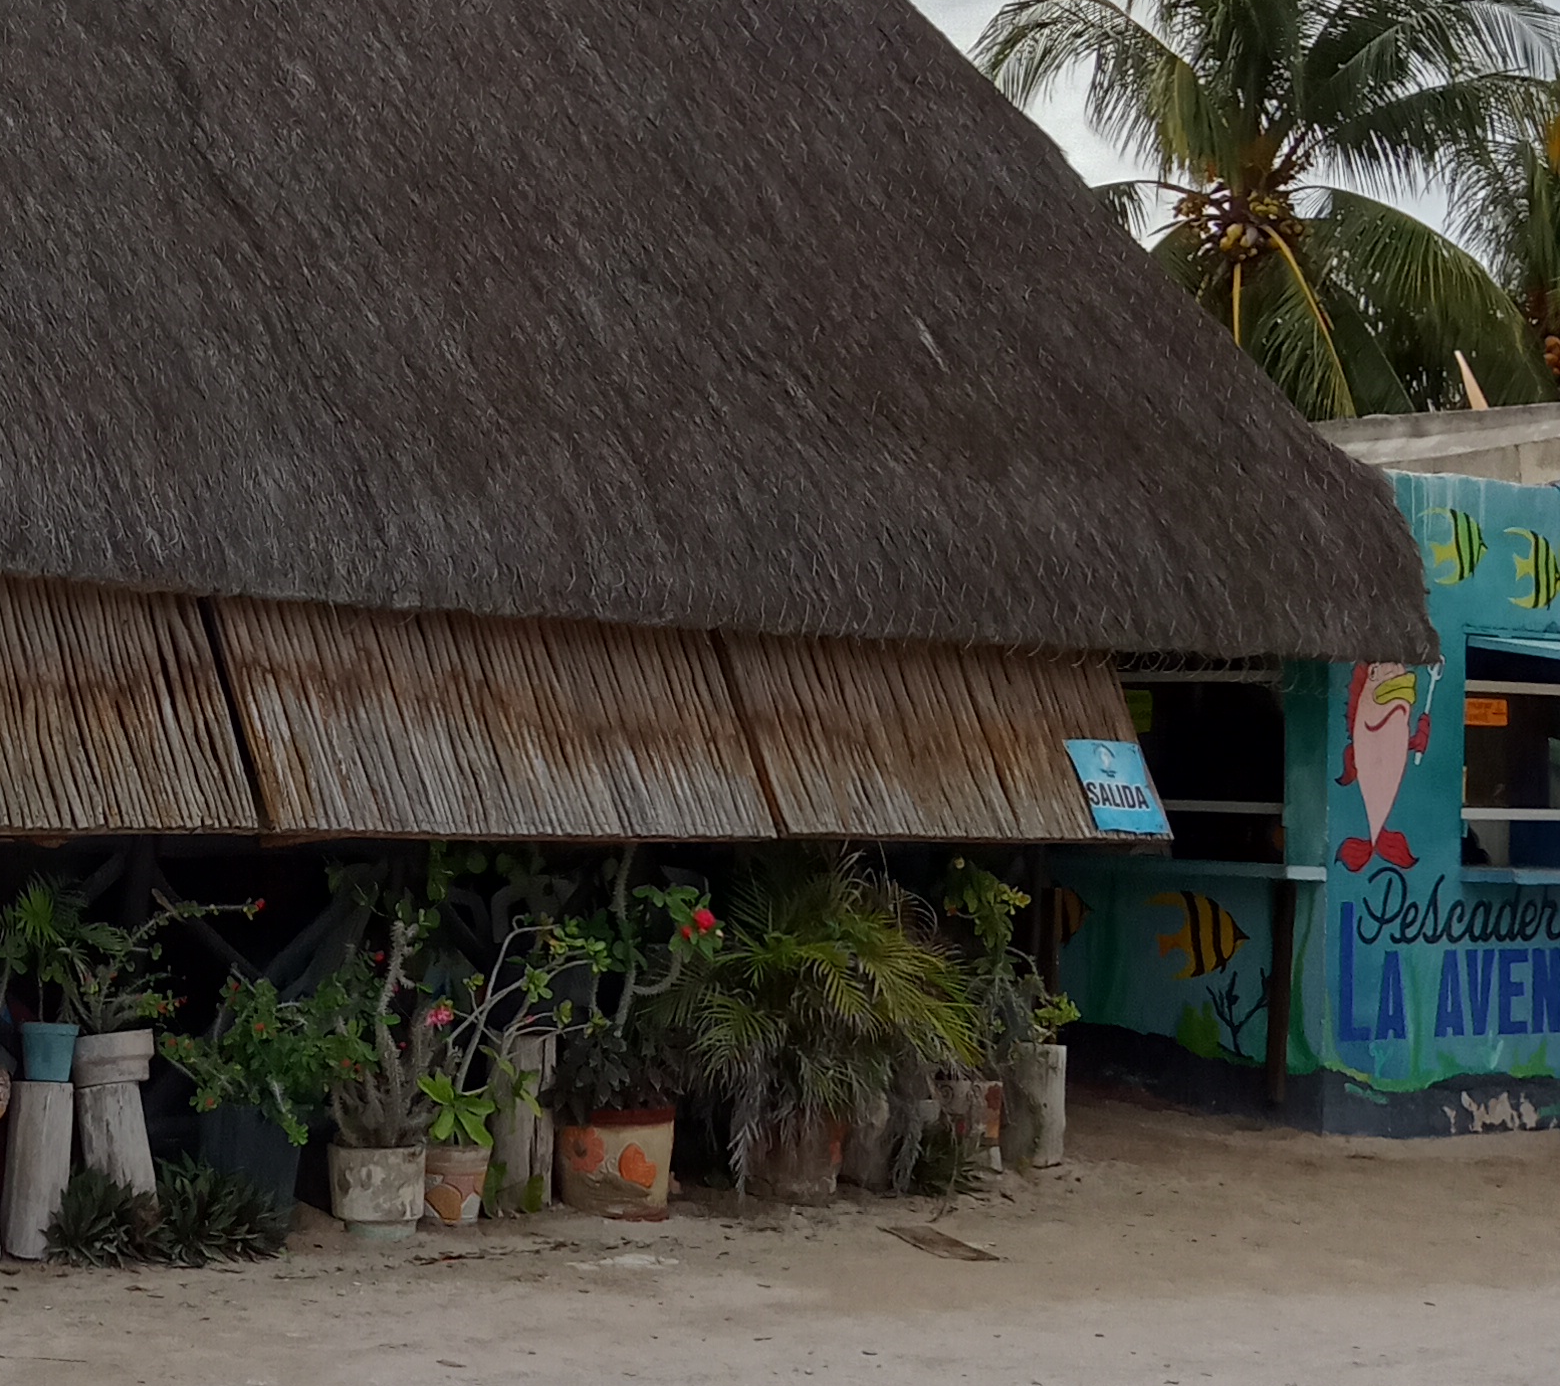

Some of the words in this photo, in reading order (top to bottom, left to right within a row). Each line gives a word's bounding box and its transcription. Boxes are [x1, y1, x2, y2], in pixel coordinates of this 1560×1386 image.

[1086, 781, 1150, 809] SALIDA
[1340, 901, 1407, 1041] LA
[1434, 948, 1560, 1038] AVEN
